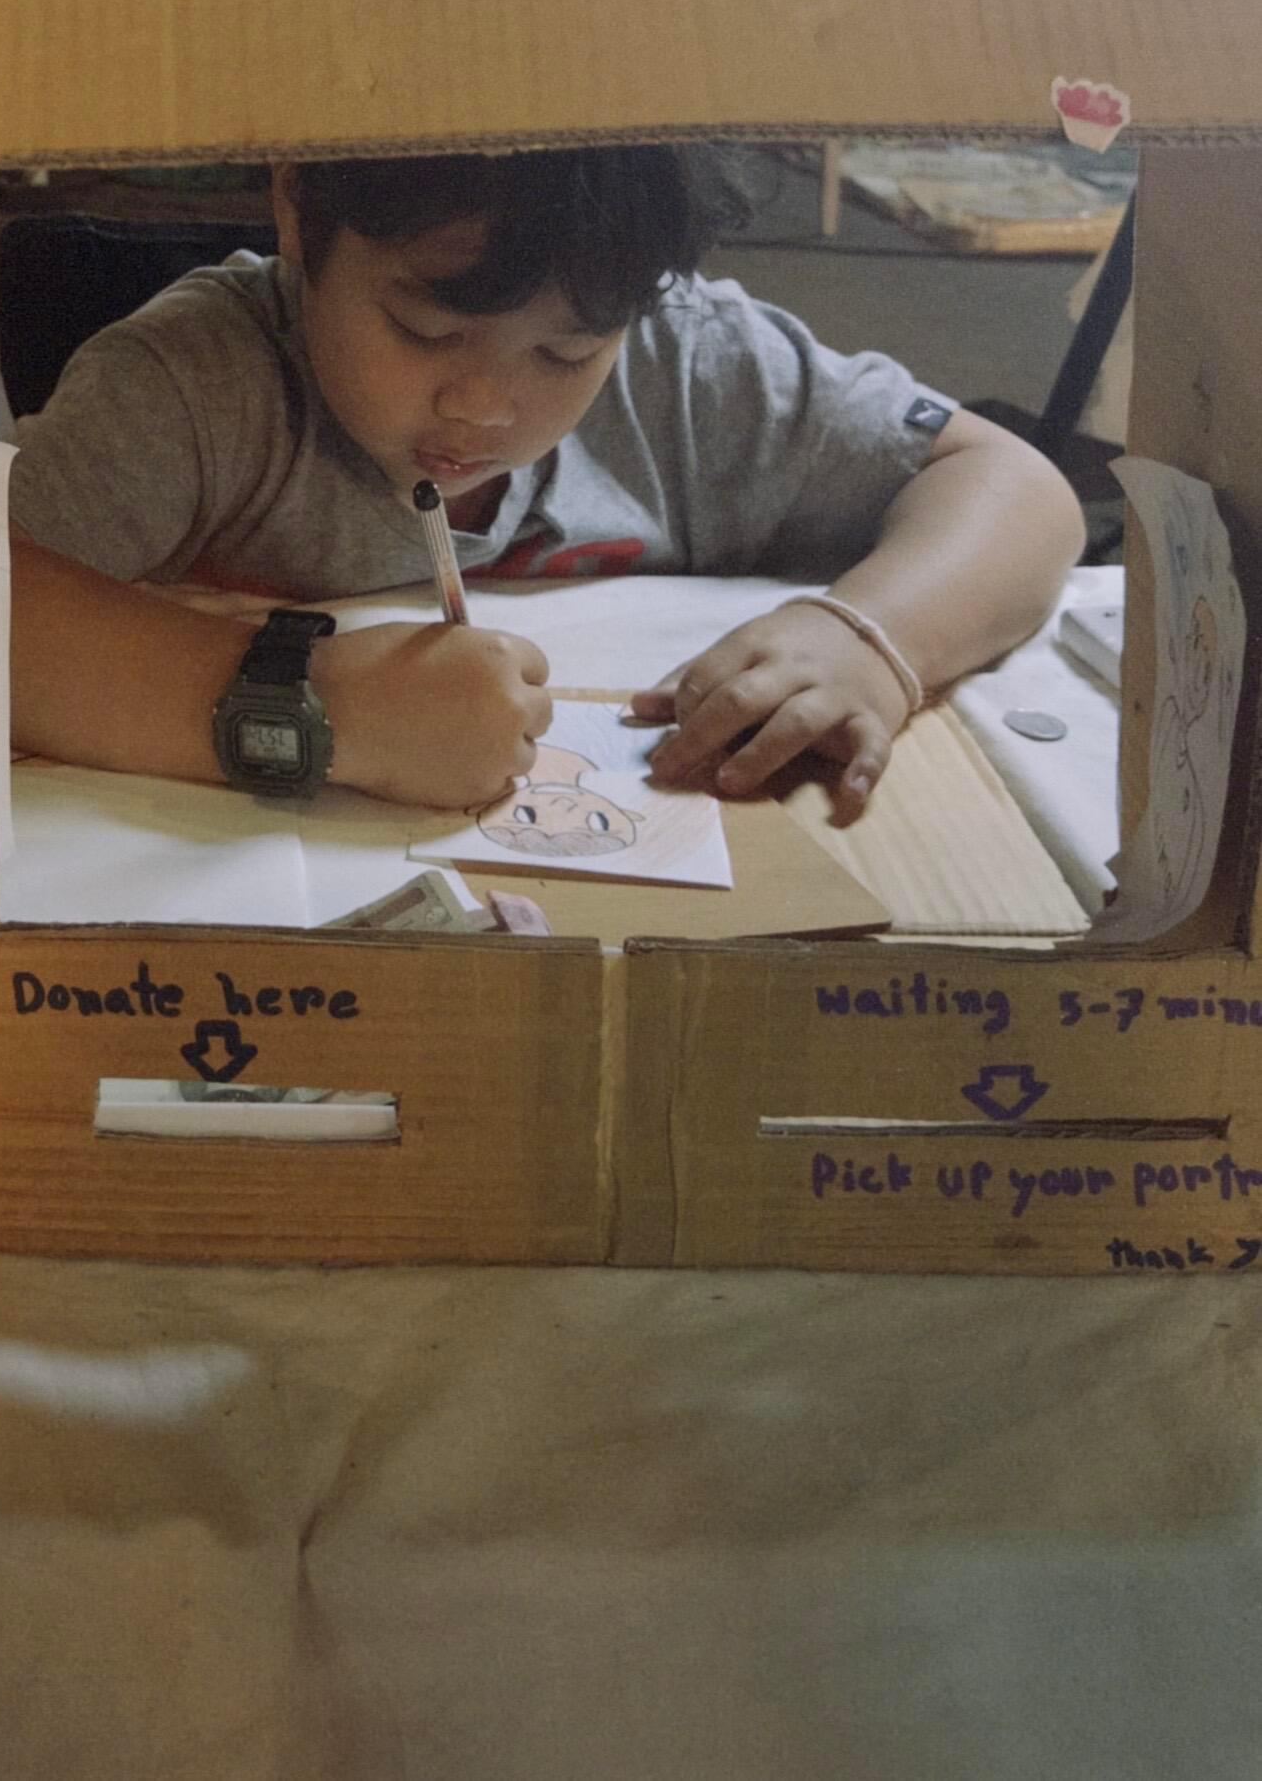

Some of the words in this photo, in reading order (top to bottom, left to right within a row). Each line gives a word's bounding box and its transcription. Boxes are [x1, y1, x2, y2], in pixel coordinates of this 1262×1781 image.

[13, 961, 184, 1018] Donate
[215, 972, 360, 1019] here
[1059, 987, 1144, 1032] 5-7
[812, 1152, 913, 1199] Pick
[939, 1160, 992, 1200] up
[1009, 1166, 1116, 1218] your
[1106, 1236, 1215, 1270] thank
